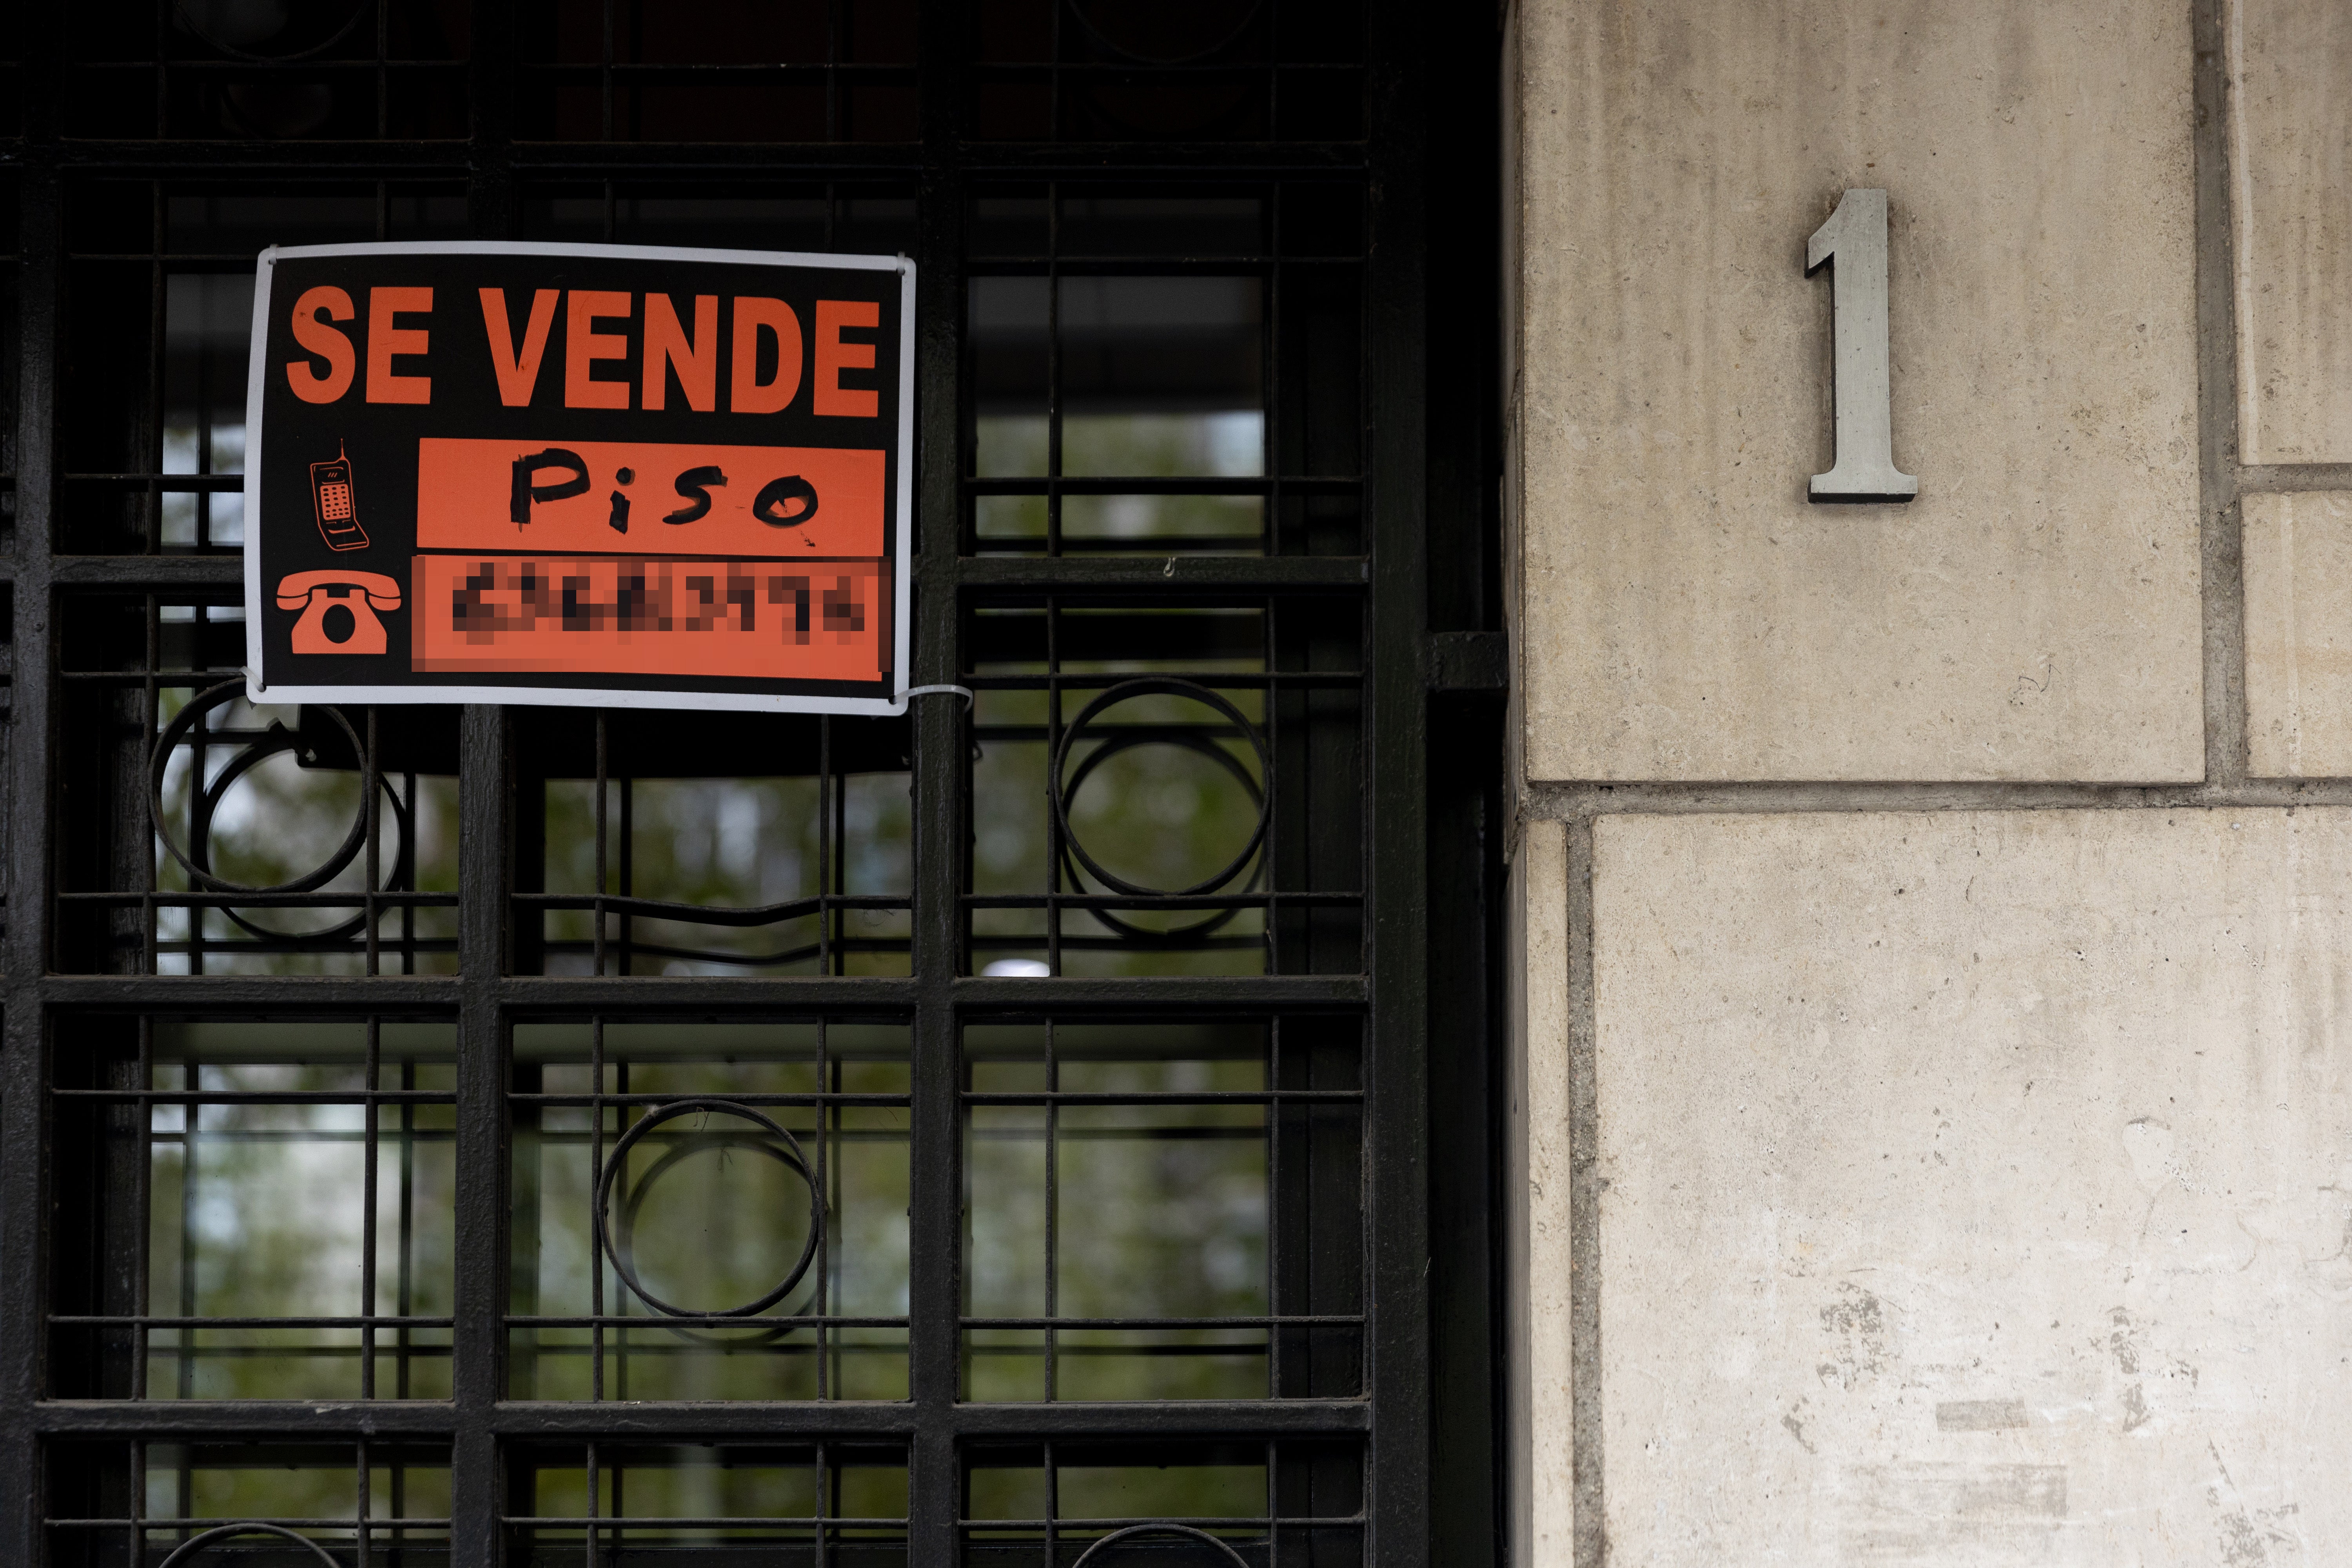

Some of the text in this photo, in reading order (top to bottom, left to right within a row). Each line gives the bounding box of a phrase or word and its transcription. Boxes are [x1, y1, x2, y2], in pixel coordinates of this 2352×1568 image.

[287, 286, 880, 417] SE VENDE
[1806, 188, 1918, 503] 1
[510, 448, 818, 535] Piso
